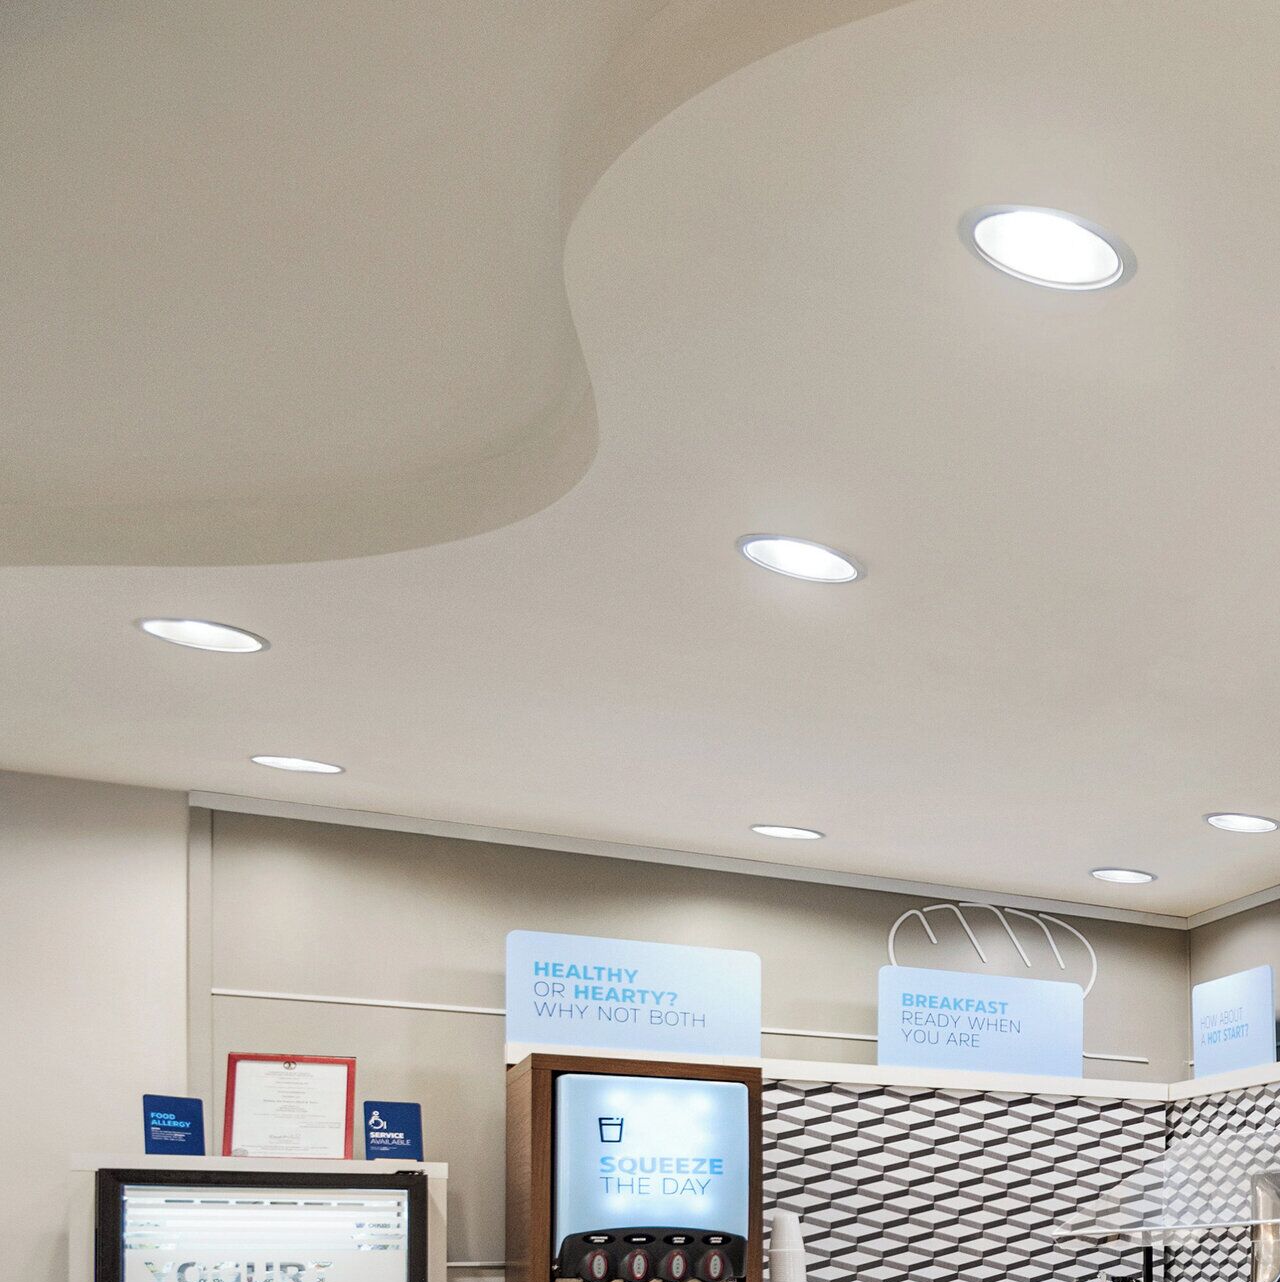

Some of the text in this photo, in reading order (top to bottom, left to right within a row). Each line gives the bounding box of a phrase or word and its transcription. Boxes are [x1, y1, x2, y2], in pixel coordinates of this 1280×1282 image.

[533, 961, 639, 984] HEALTHY
[533, 981, 678, 1007] OR HEARTY?
[901, 992, 1009, 1015] BREAKFAST
[533, 1001, 706, 1028] WHY NOT BOTH
[901, 1011, 1022, 1034] READY WHEN
[1219, 1006, 1244, 1026] ABOUT
[901, 1028, 980, 1048] YOU ARE
[1207, 1029, 1222, 1045] HOT
[1223, 1023, 1249, 1042] START?
[150, 1112, 176, 1120] FOOD
[151, 1120, 191, 1128] ALLERGY
[370, 1131, 405, 1139] SERVICE
[600, 1156, 724, 1175] SQUEEZE
[600, 1176, 712, 1196] THE DAY
